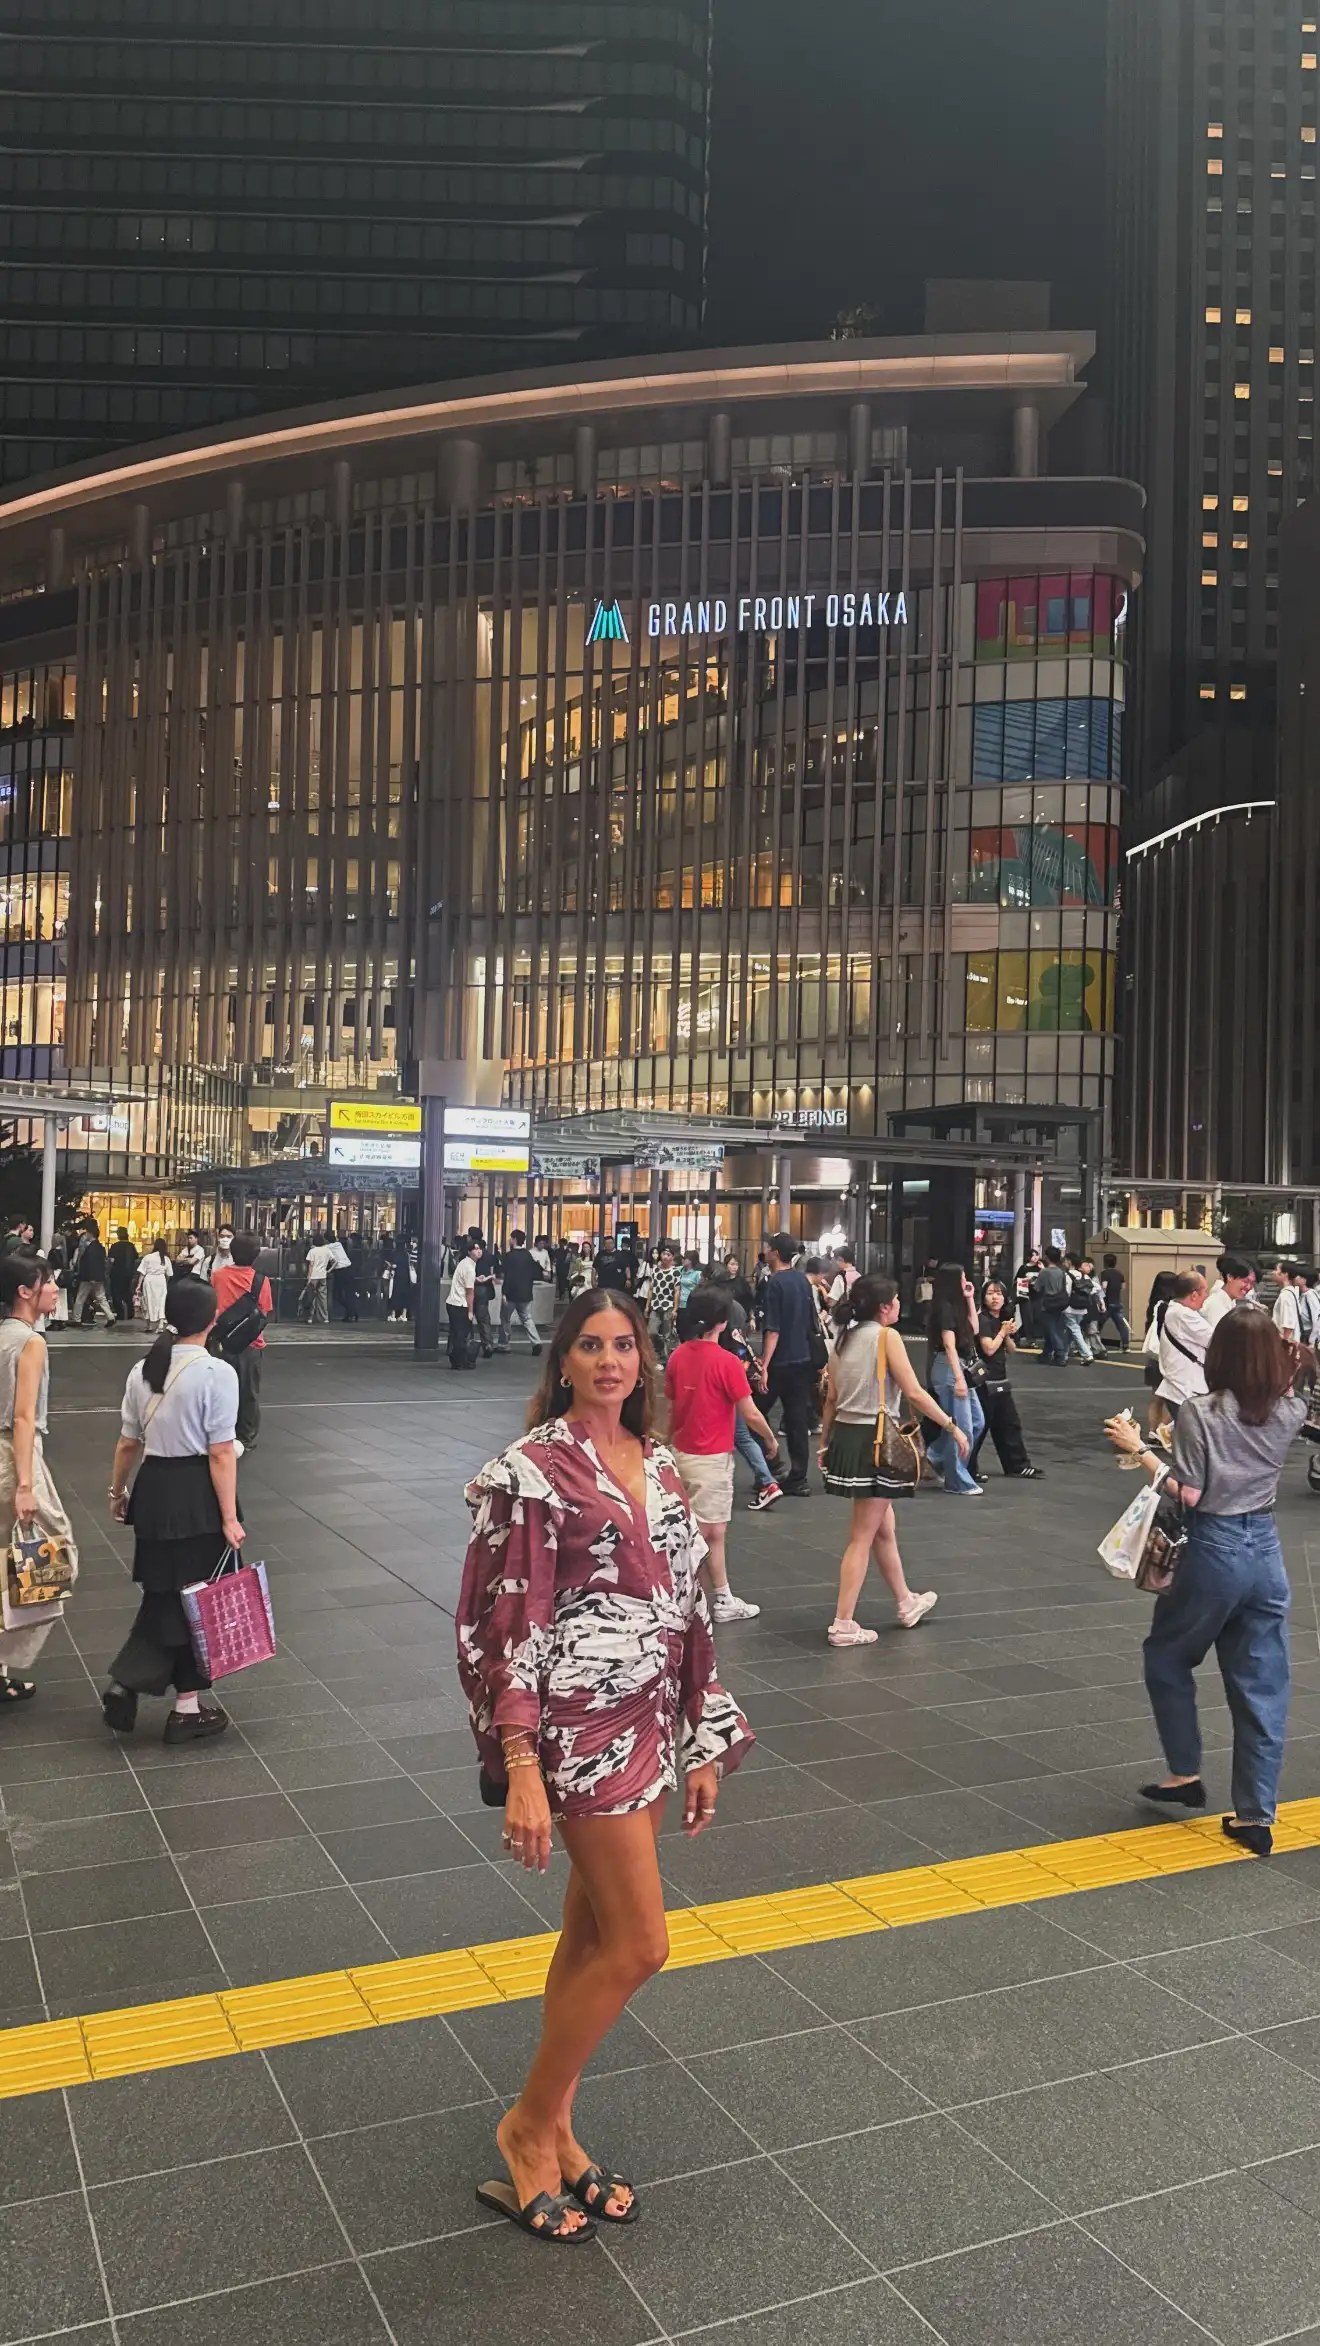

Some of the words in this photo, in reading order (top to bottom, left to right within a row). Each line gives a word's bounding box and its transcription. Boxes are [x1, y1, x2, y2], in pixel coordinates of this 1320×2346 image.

[648, 600, 727, 637] GRAND
[739, 595, 816, 632] FRONT
[825, 591, 908, 628] OSAKA
[767, 759, 814, 775] PRS
